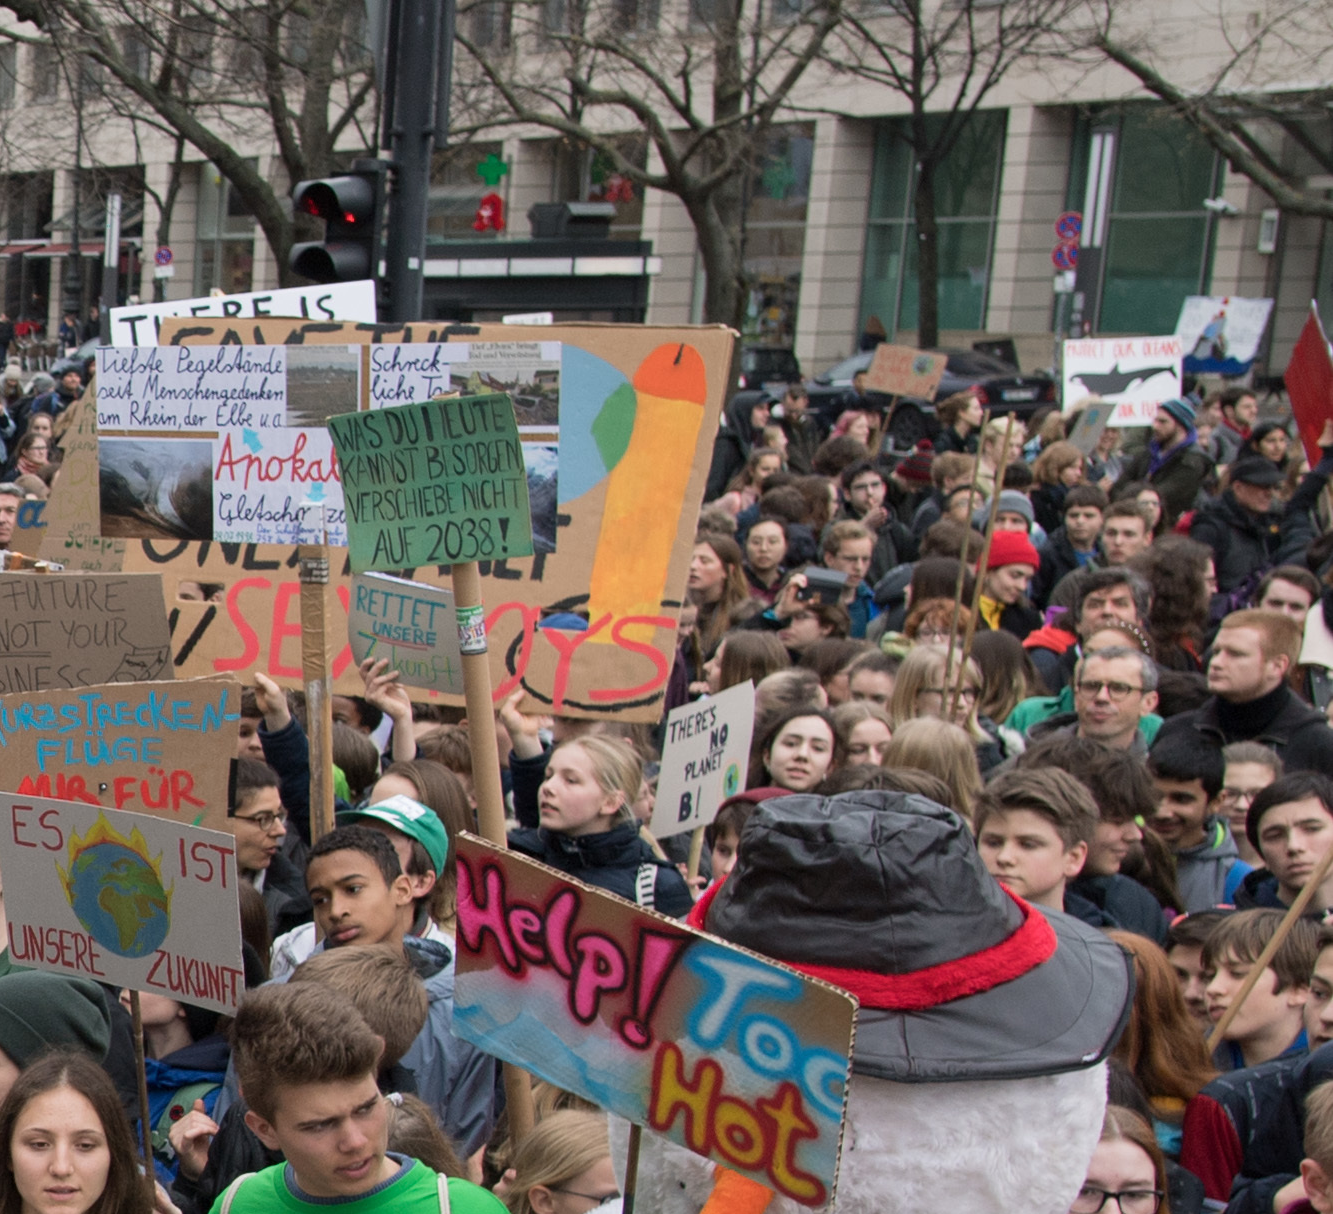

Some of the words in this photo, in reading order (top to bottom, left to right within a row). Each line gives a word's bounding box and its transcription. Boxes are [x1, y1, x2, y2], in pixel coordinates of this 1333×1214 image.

[96, 347, 163, 374] Tiefste
[177, 348, 283, 379] Pegelstände
[97, 377, 133, 400] seit
[143, 375, 284, 406] Menschengedenken
[98, 412, 121, 425] am
[184, 405, 207, 426] der
[216, 401, 252, 428] Elbe
[330, 413, 382, 452] WAS
[385, 408, 419, 445] DU
[339, 447, 418, 488] KANNST
[347, 482, 456, 525] VERSCHIEBE
[462, 478, 522, 512] NICHT
[371, 526, 416, 566] AUF
[425, 516, 510, 562] 2038!
[2, 579, 129, 613] FUTURE
[356, 585, 446, 629] RETTET
[60, 617, 136, 648] YOUR
[372, 620, 437, 647] UNSERE
[358, 630, 456, 687] Zkunft
[669, 704, 718, 744] THERE'S
[709, 724, 730, 749] NO
[36, 730, 163, 772] FLÜGE
[685, 750, 724, 782] PLANET
[113, 766, 206, 811] FÜR
[12, 805, 63, 851] ES
[179, 838, 234, 888] IST
[8, 921, 105, 976] UNSERE
[146, 949, 243, 1007] ZUKUNFT
[456, 852, 692, 1050] Help!
[648, 1040, 827, 1207] Hot
